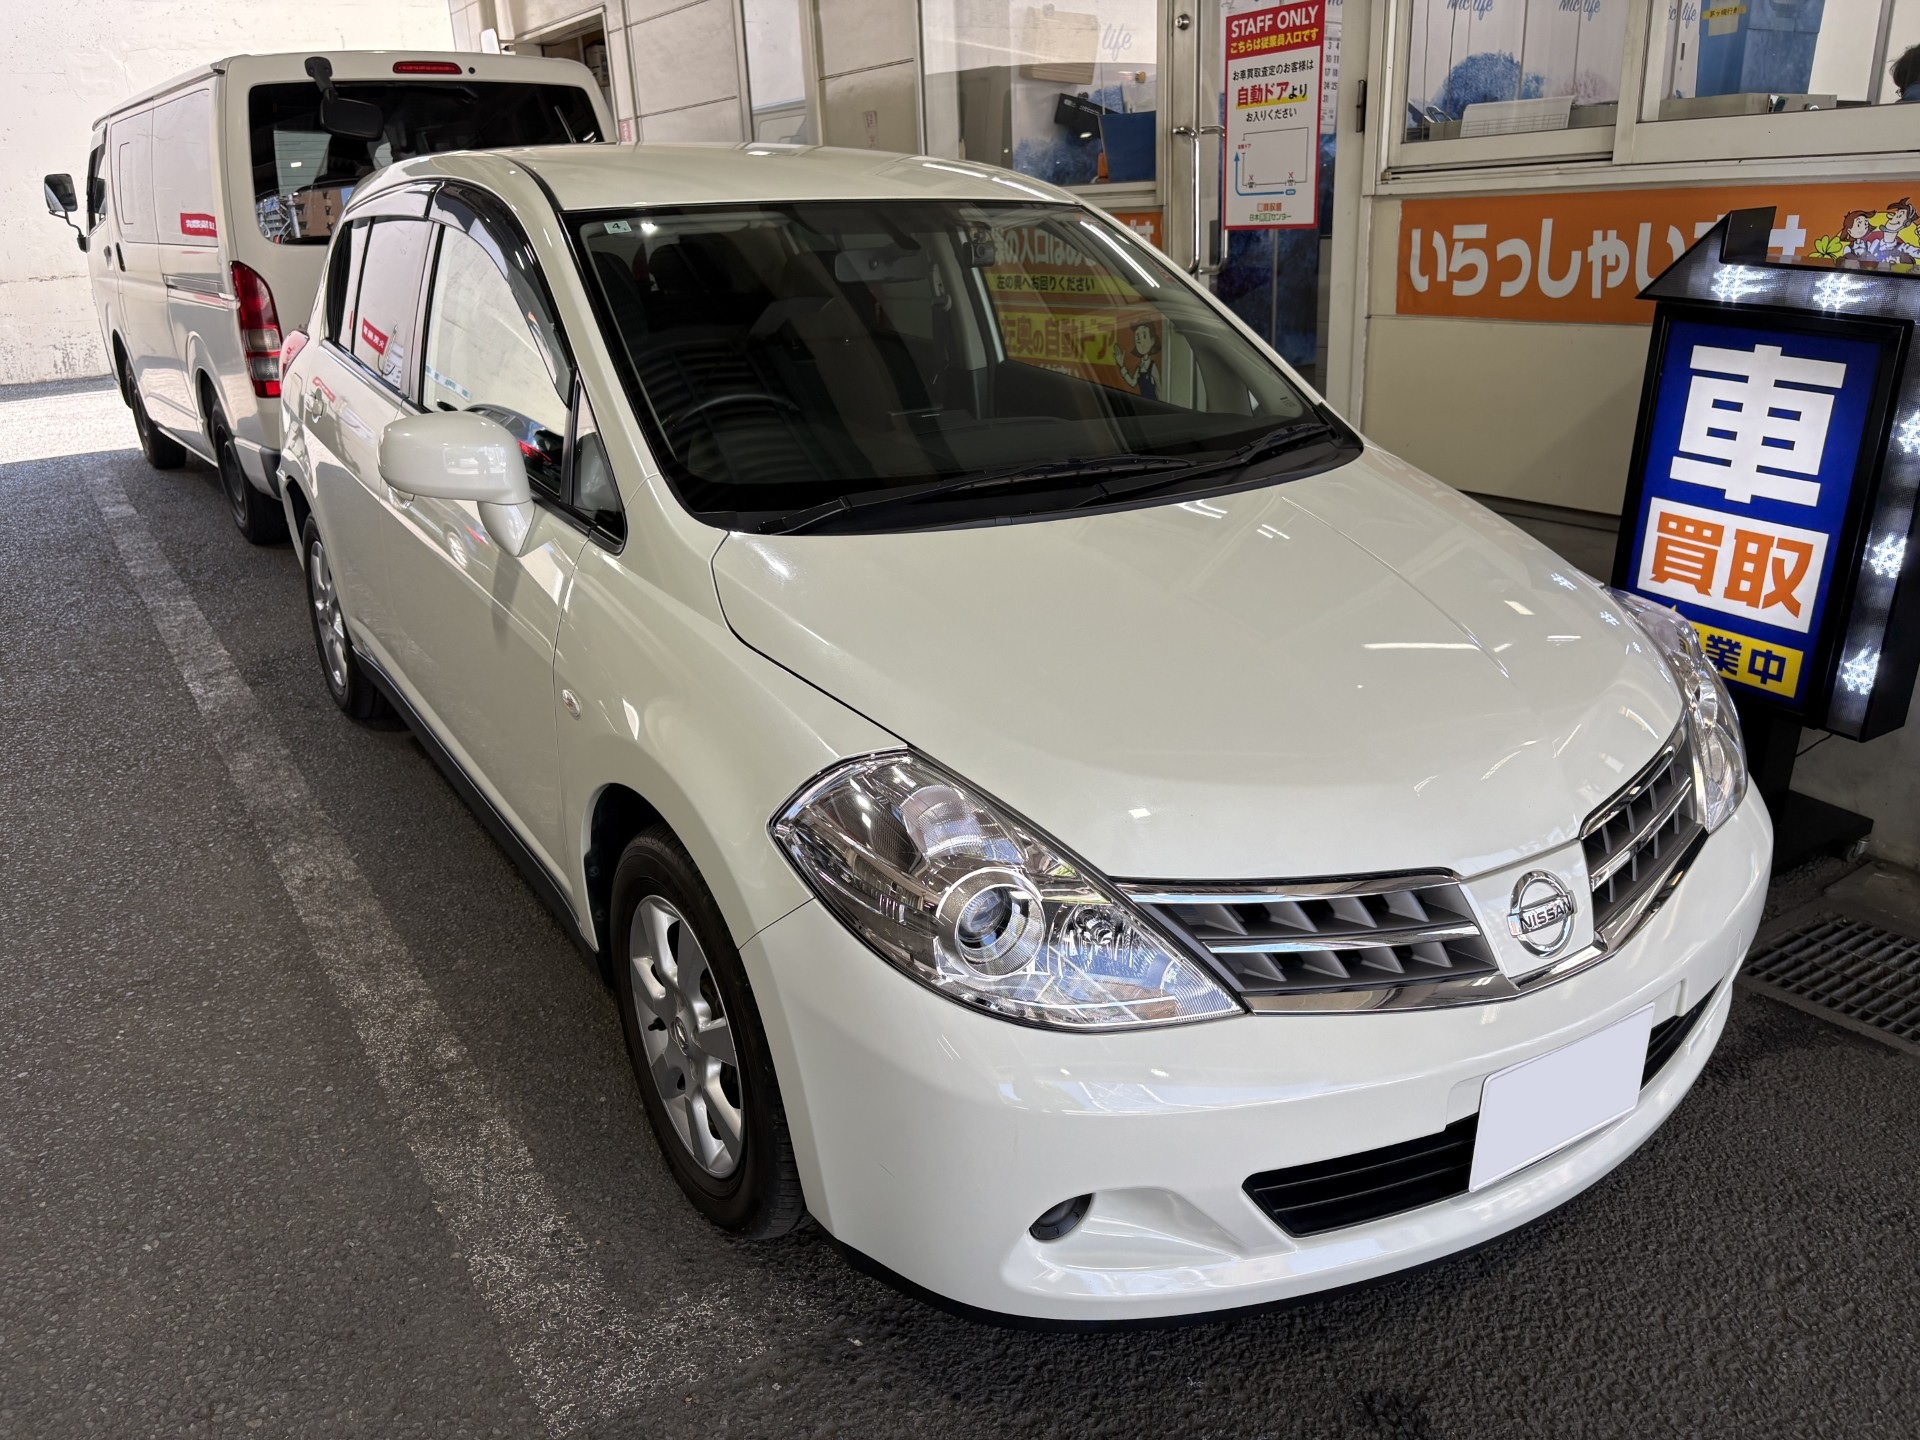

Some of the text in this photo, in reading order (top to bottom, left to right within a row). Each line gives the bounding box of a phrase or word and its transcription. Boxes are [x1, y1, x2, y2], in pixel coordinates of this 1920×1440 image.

[1231, 5, 1319, 38] STAFF ONLY
[1681, 2, 1697, 29] life
[1102, 23, 1132, 61] life
[1230, 27, 1319, 54] こちらは従業員入口です
[1232, 59, 1314, 81] お車買取査定のお客様は
[1237, 81, 1307, 107] 自動ドアより
[1246, 107, 1297, 122] お入りください
[1669, 343, 1847, 507] 車
[1650, 511, 1814, 619] 買取
[1519, 900, 1572, 930] NISSAN
